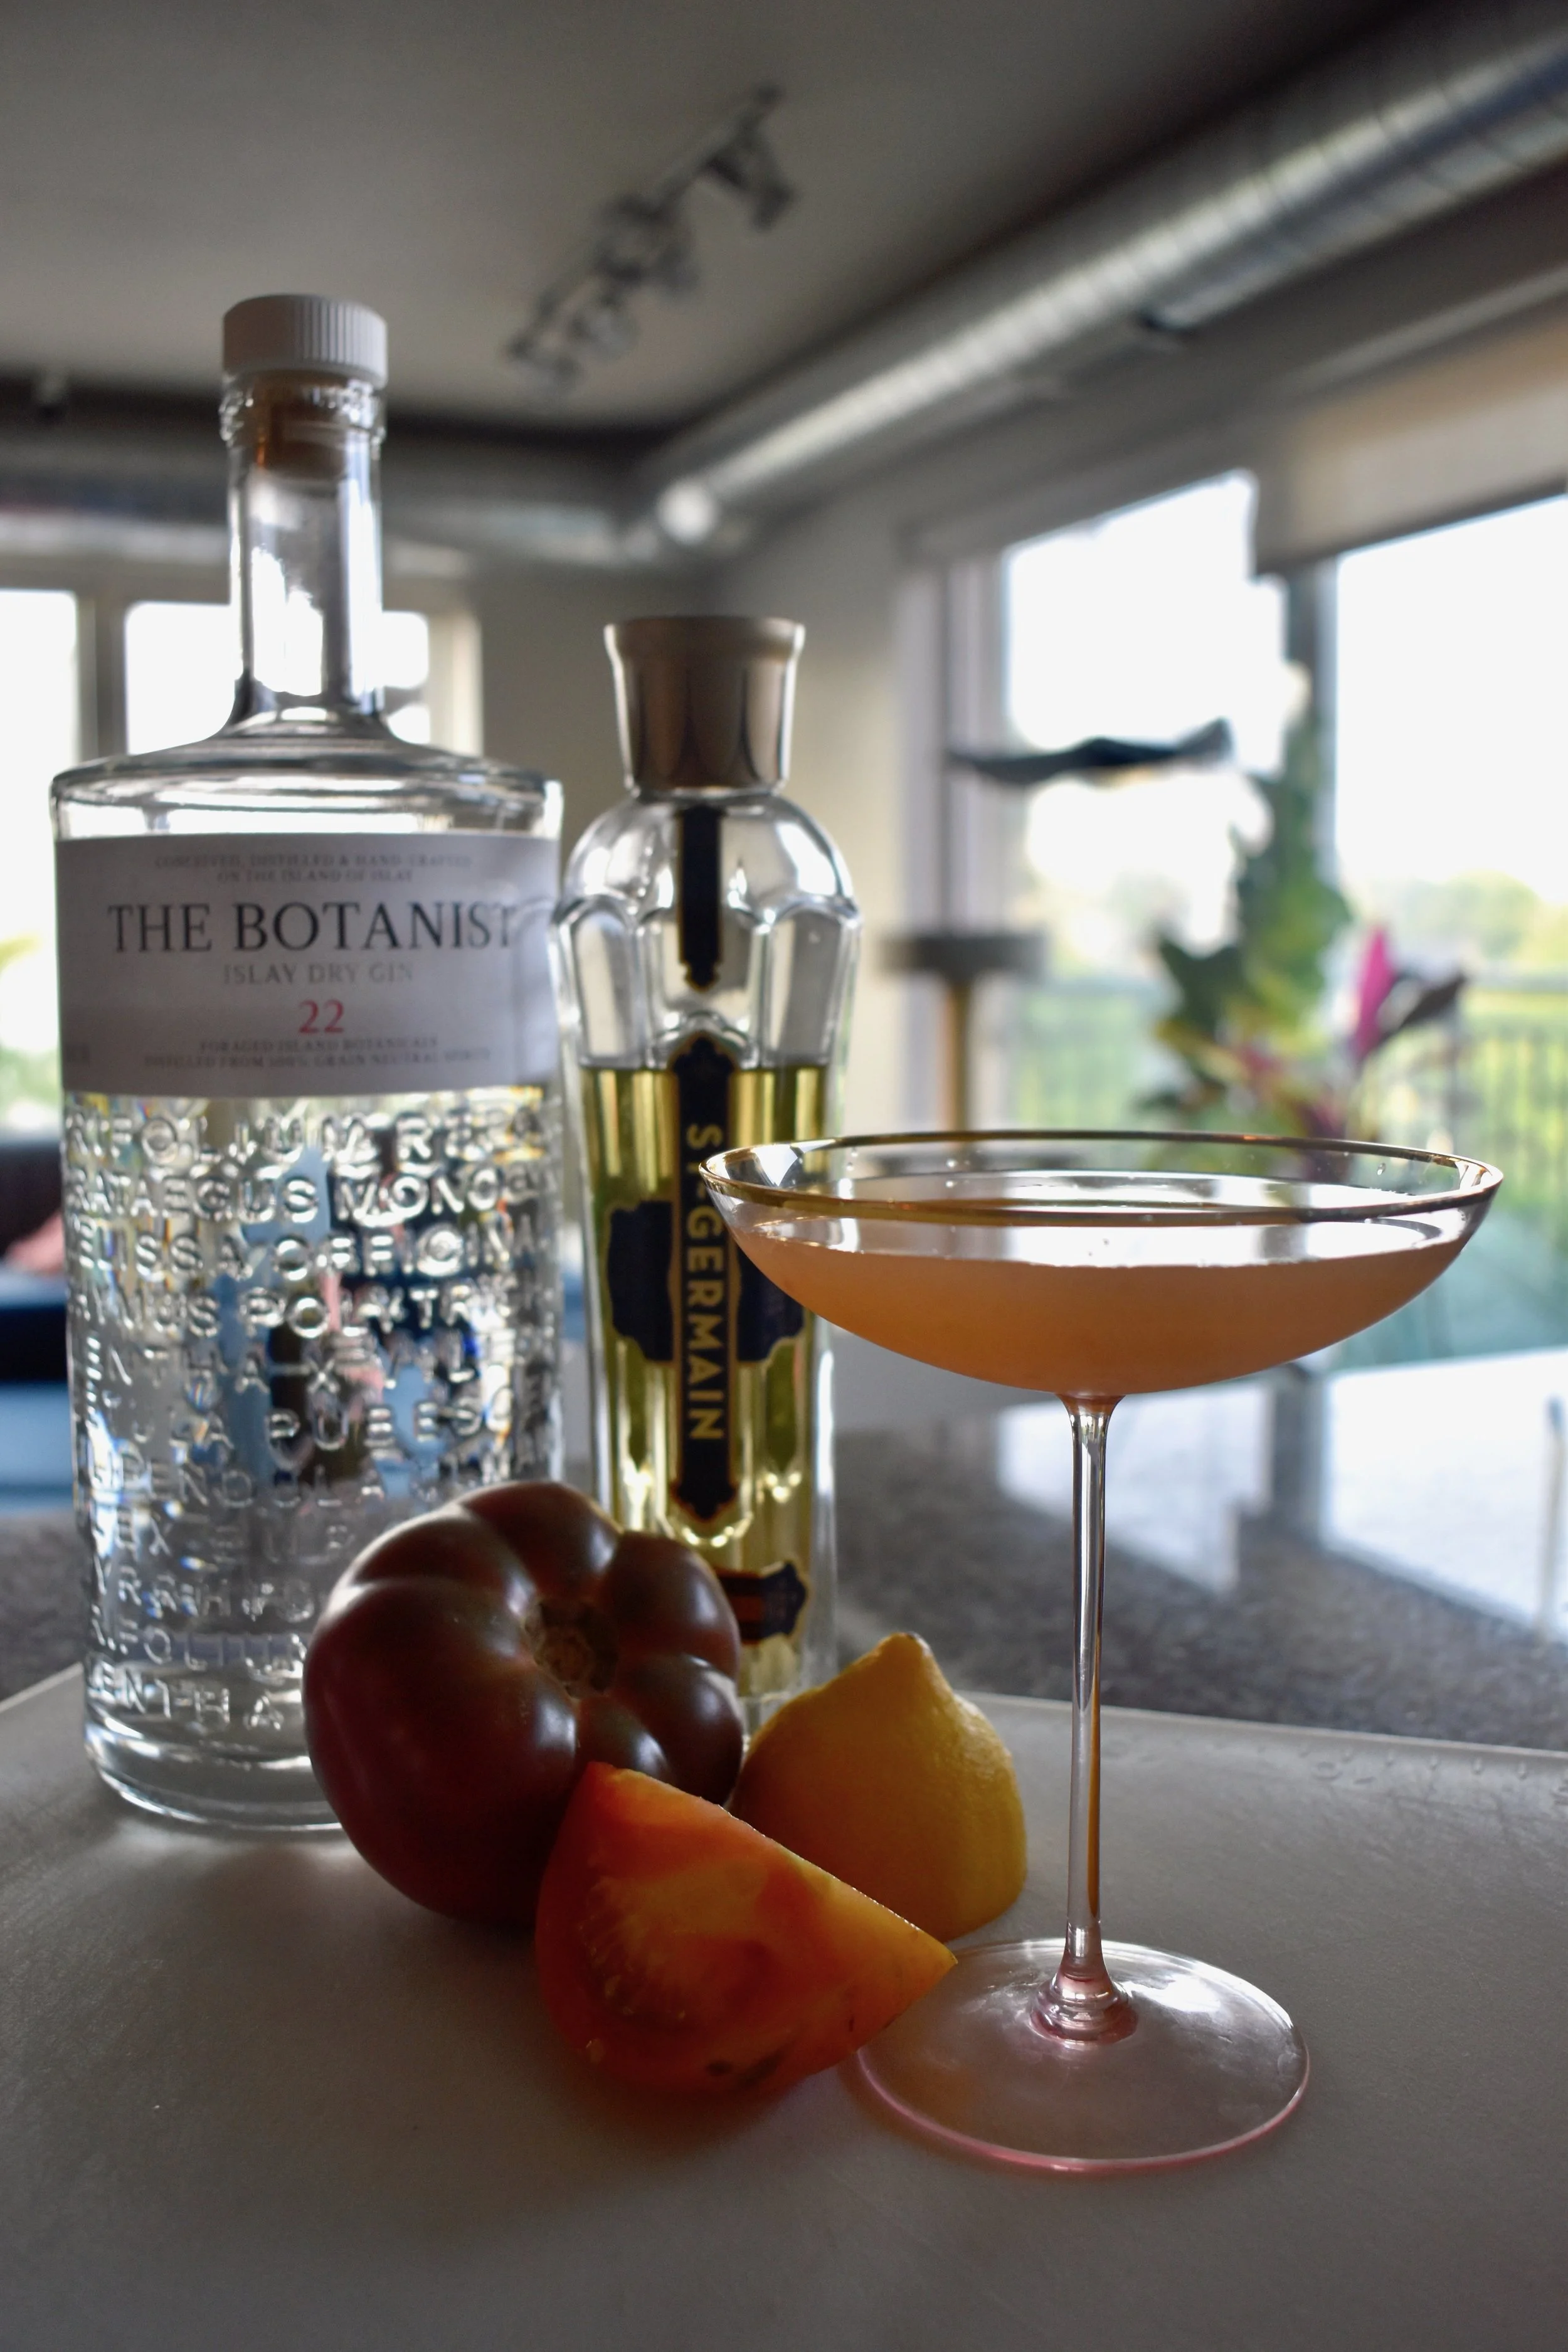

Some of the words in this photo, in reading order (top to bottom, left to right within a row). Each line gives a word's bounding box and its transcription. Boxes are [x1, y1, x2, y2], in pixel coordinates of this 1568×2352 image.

[107, 902, 213, 953] THE
[232, 900, 517, 952] BOTANIST
[223, 962, 297, 985] ISLAY
[308, 962, 359, 984] DRY
[369, 961, 413, 983] GIN
[299, 999, 345, 1034] 22
